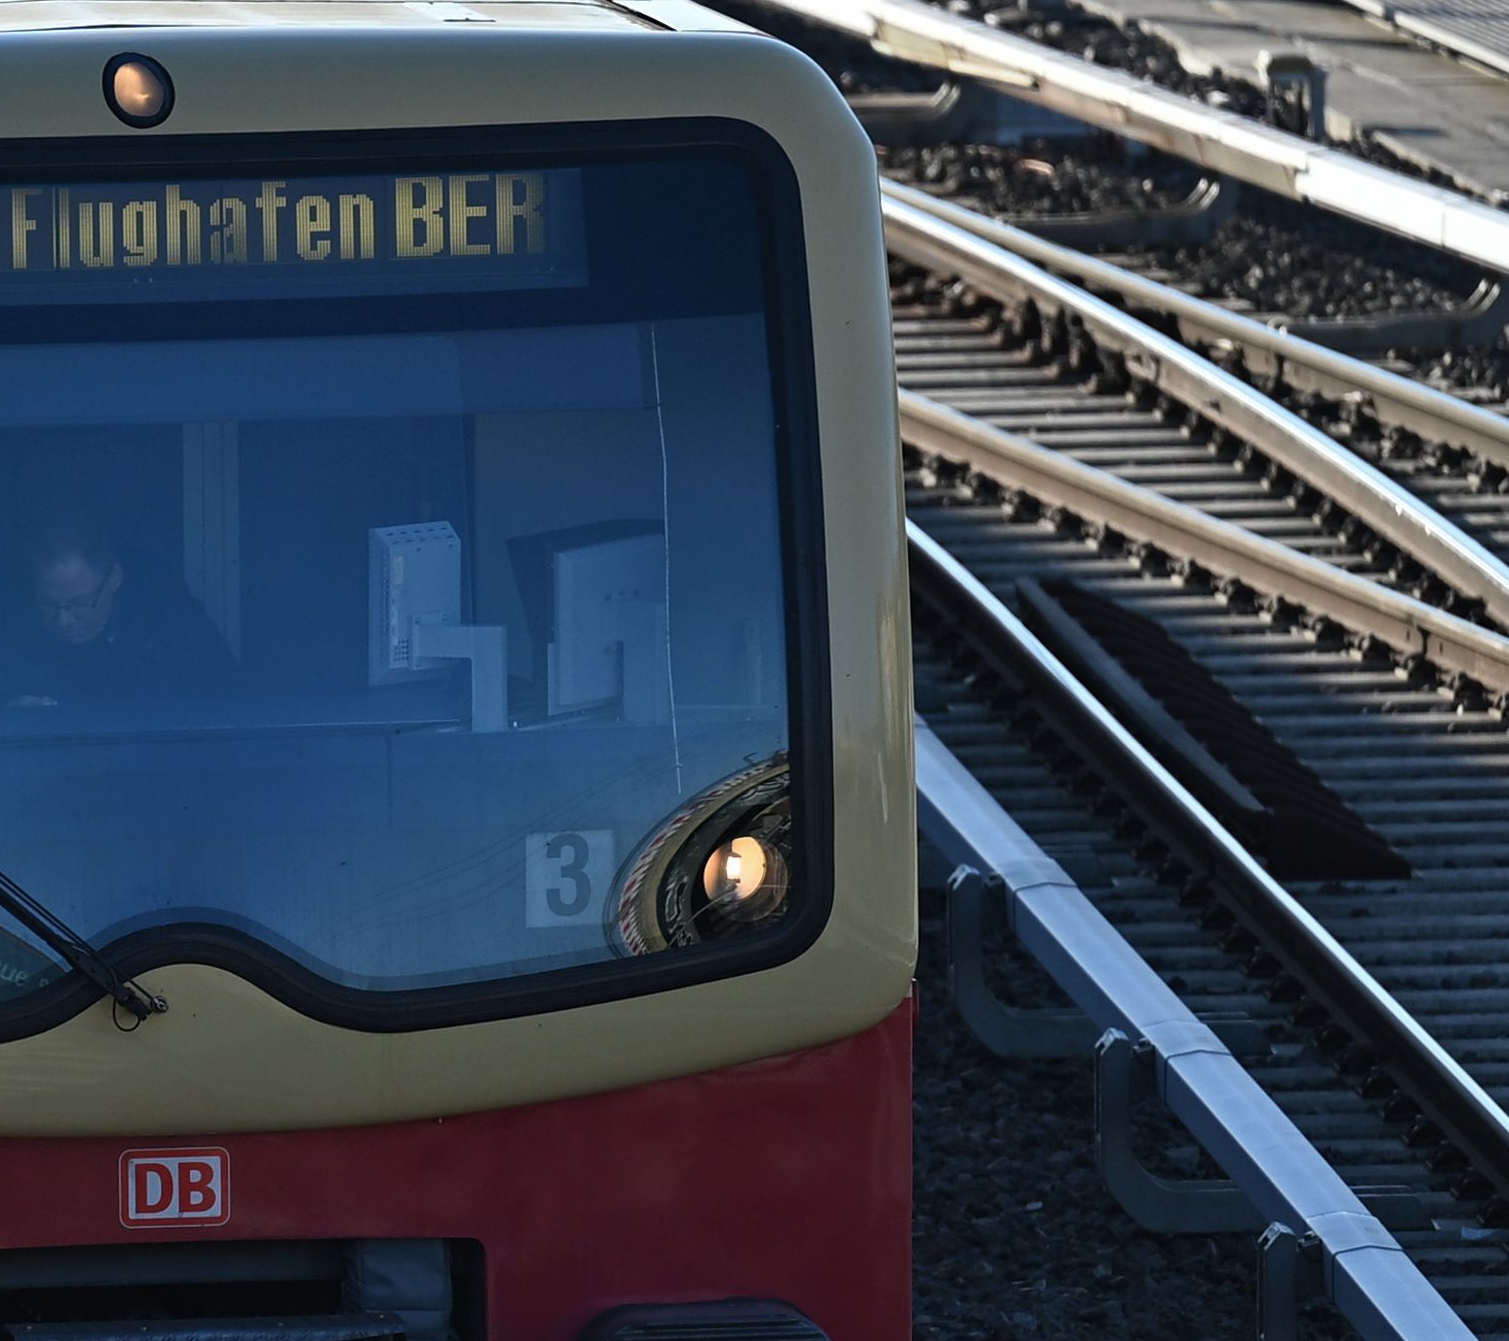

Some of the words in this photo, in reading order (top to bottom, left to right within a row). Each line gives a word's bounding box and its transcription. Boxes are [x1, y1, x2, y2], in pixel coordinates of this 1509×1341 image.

[11, 181, 374, 270] Flughafen
[393, 172, 544, 258] BER
[546, 834, 592, 917] 3
[134, 1161, 217, 1215] DB
